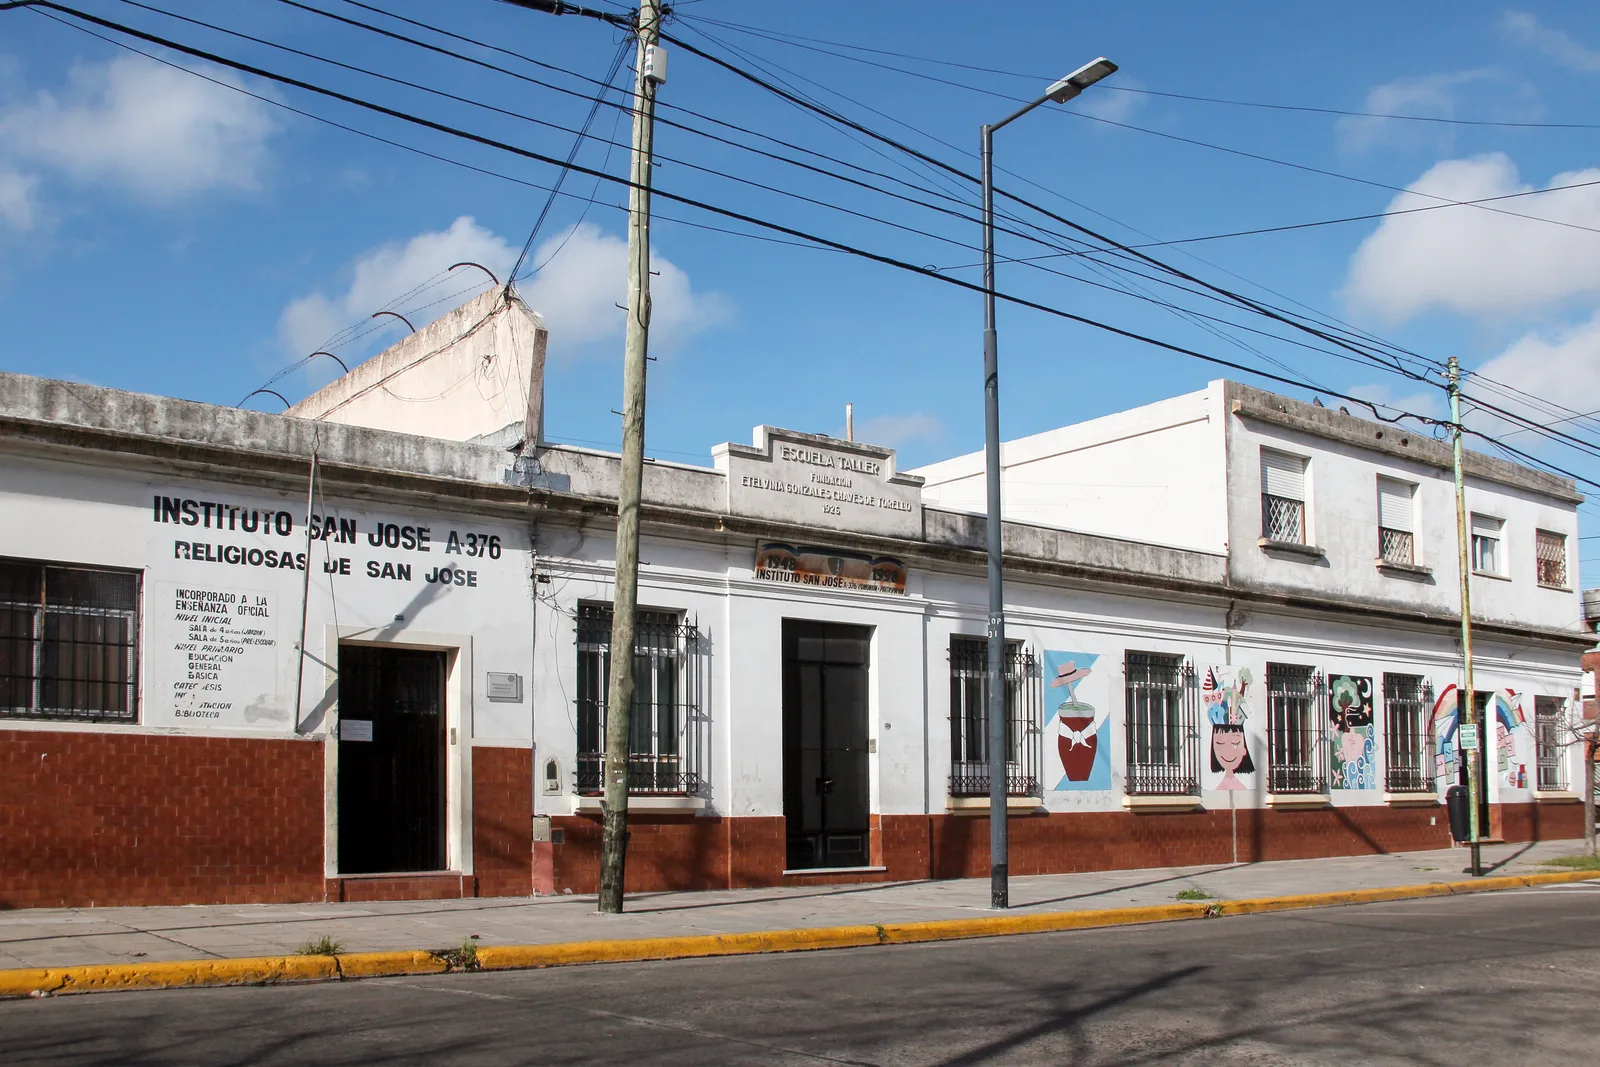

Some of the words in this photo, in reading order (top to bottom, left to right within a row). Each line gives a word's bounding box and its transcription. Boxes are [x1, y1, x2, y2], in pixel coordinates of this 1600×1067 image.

[781, 446, 835, 468] ESCUELA
[838, 457, 880, 476] TALLER
[742, 476, 784, 492] ETELVINA
[786, 483, 832, 500] GONZALES
[834, 491, 864, 505] CHAVES
[865, 496, 874, 506] DE
[822, 504, 840, 515] 1926
[154, 496, 292, 536] INSTITUTO
[305, 515, 356, 544] SAN
[368, 522, 430, 552] JOSE
[175, 540, 306, 570] RELIGIOSAS
[324, 556, 350, 575] DE
[366, 561, 411, 581] SAN
[425, 567, 477, 587] JOSE
[768, 554, 796, 571] 1948
[756, 569, 800, 583] INSTITUTO
[822, 576, 842, 588] JOSE
[176, 589, 236, 603] INCORPORADO
[241, 595, 247, 604] A
[256, 596, 268, 606] LA
[176, 600, 228, 614] ENSEÑANZA
[175, 614, 198, 622] NIVEL
[202, 616, 232, 625] INICIAL
[189, 624, 207, 632] SALA
[188, 634, 208, 642] SALA
[189, 662, 222, 670] GENERAL
[189, 672, 218, 680] BASICA
